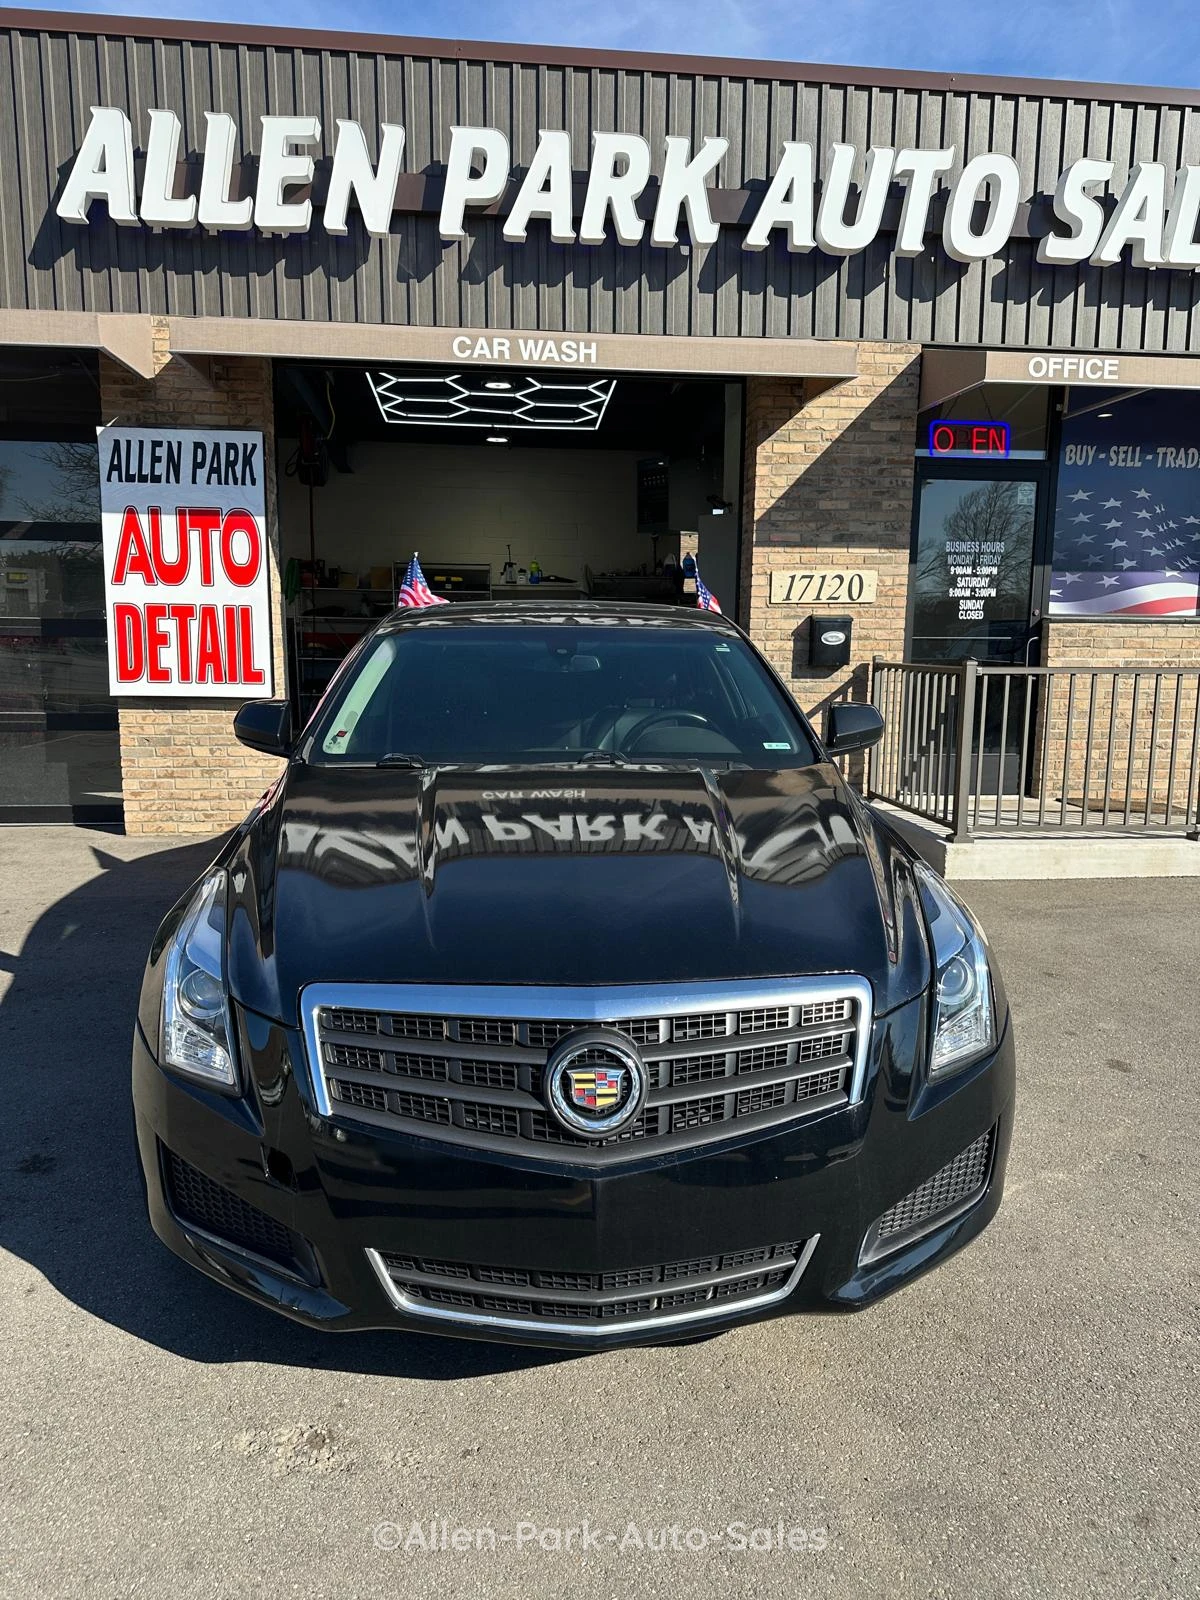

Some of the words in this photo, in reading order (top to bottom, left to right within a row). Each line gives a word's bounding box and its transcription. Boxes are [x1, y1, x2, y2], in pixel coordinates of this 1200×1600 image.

[57, 105, 405, 238] ALLEN
[439, 125, 730, 248] PARK
[742, 140, 1020, 263] AUTO
[452, 336, 510, 360] CAR
[518, 339, 597, 363] WASH
[1028, 356, 1120, 380] OFFICE
[106, 439, 182, 485] ALLEN
[191, 441, 258, 486] PARK
[1065, 444, 1097, 466] BUY
[1109, 445, 1143, 467] SELL
[1156, 446, 1200, 468] TRAD
[111, 505, 262, 587] AUTO
[945, 541, 979, 552] BUSINESS
[981, 541, 1005, 552] HOURS
[947, 554, 974, 565] MONDAY
[980, 554, 1001, 565] FRIDAY
[782, 573, 864, 602] 17120
[957, 577, 989, 587] SATURDAY
[958, 610, 984, 620] CLOSED
[959, 600, 984, 610] SUNDAY
[113, 602, 265, 685] DETAIL
